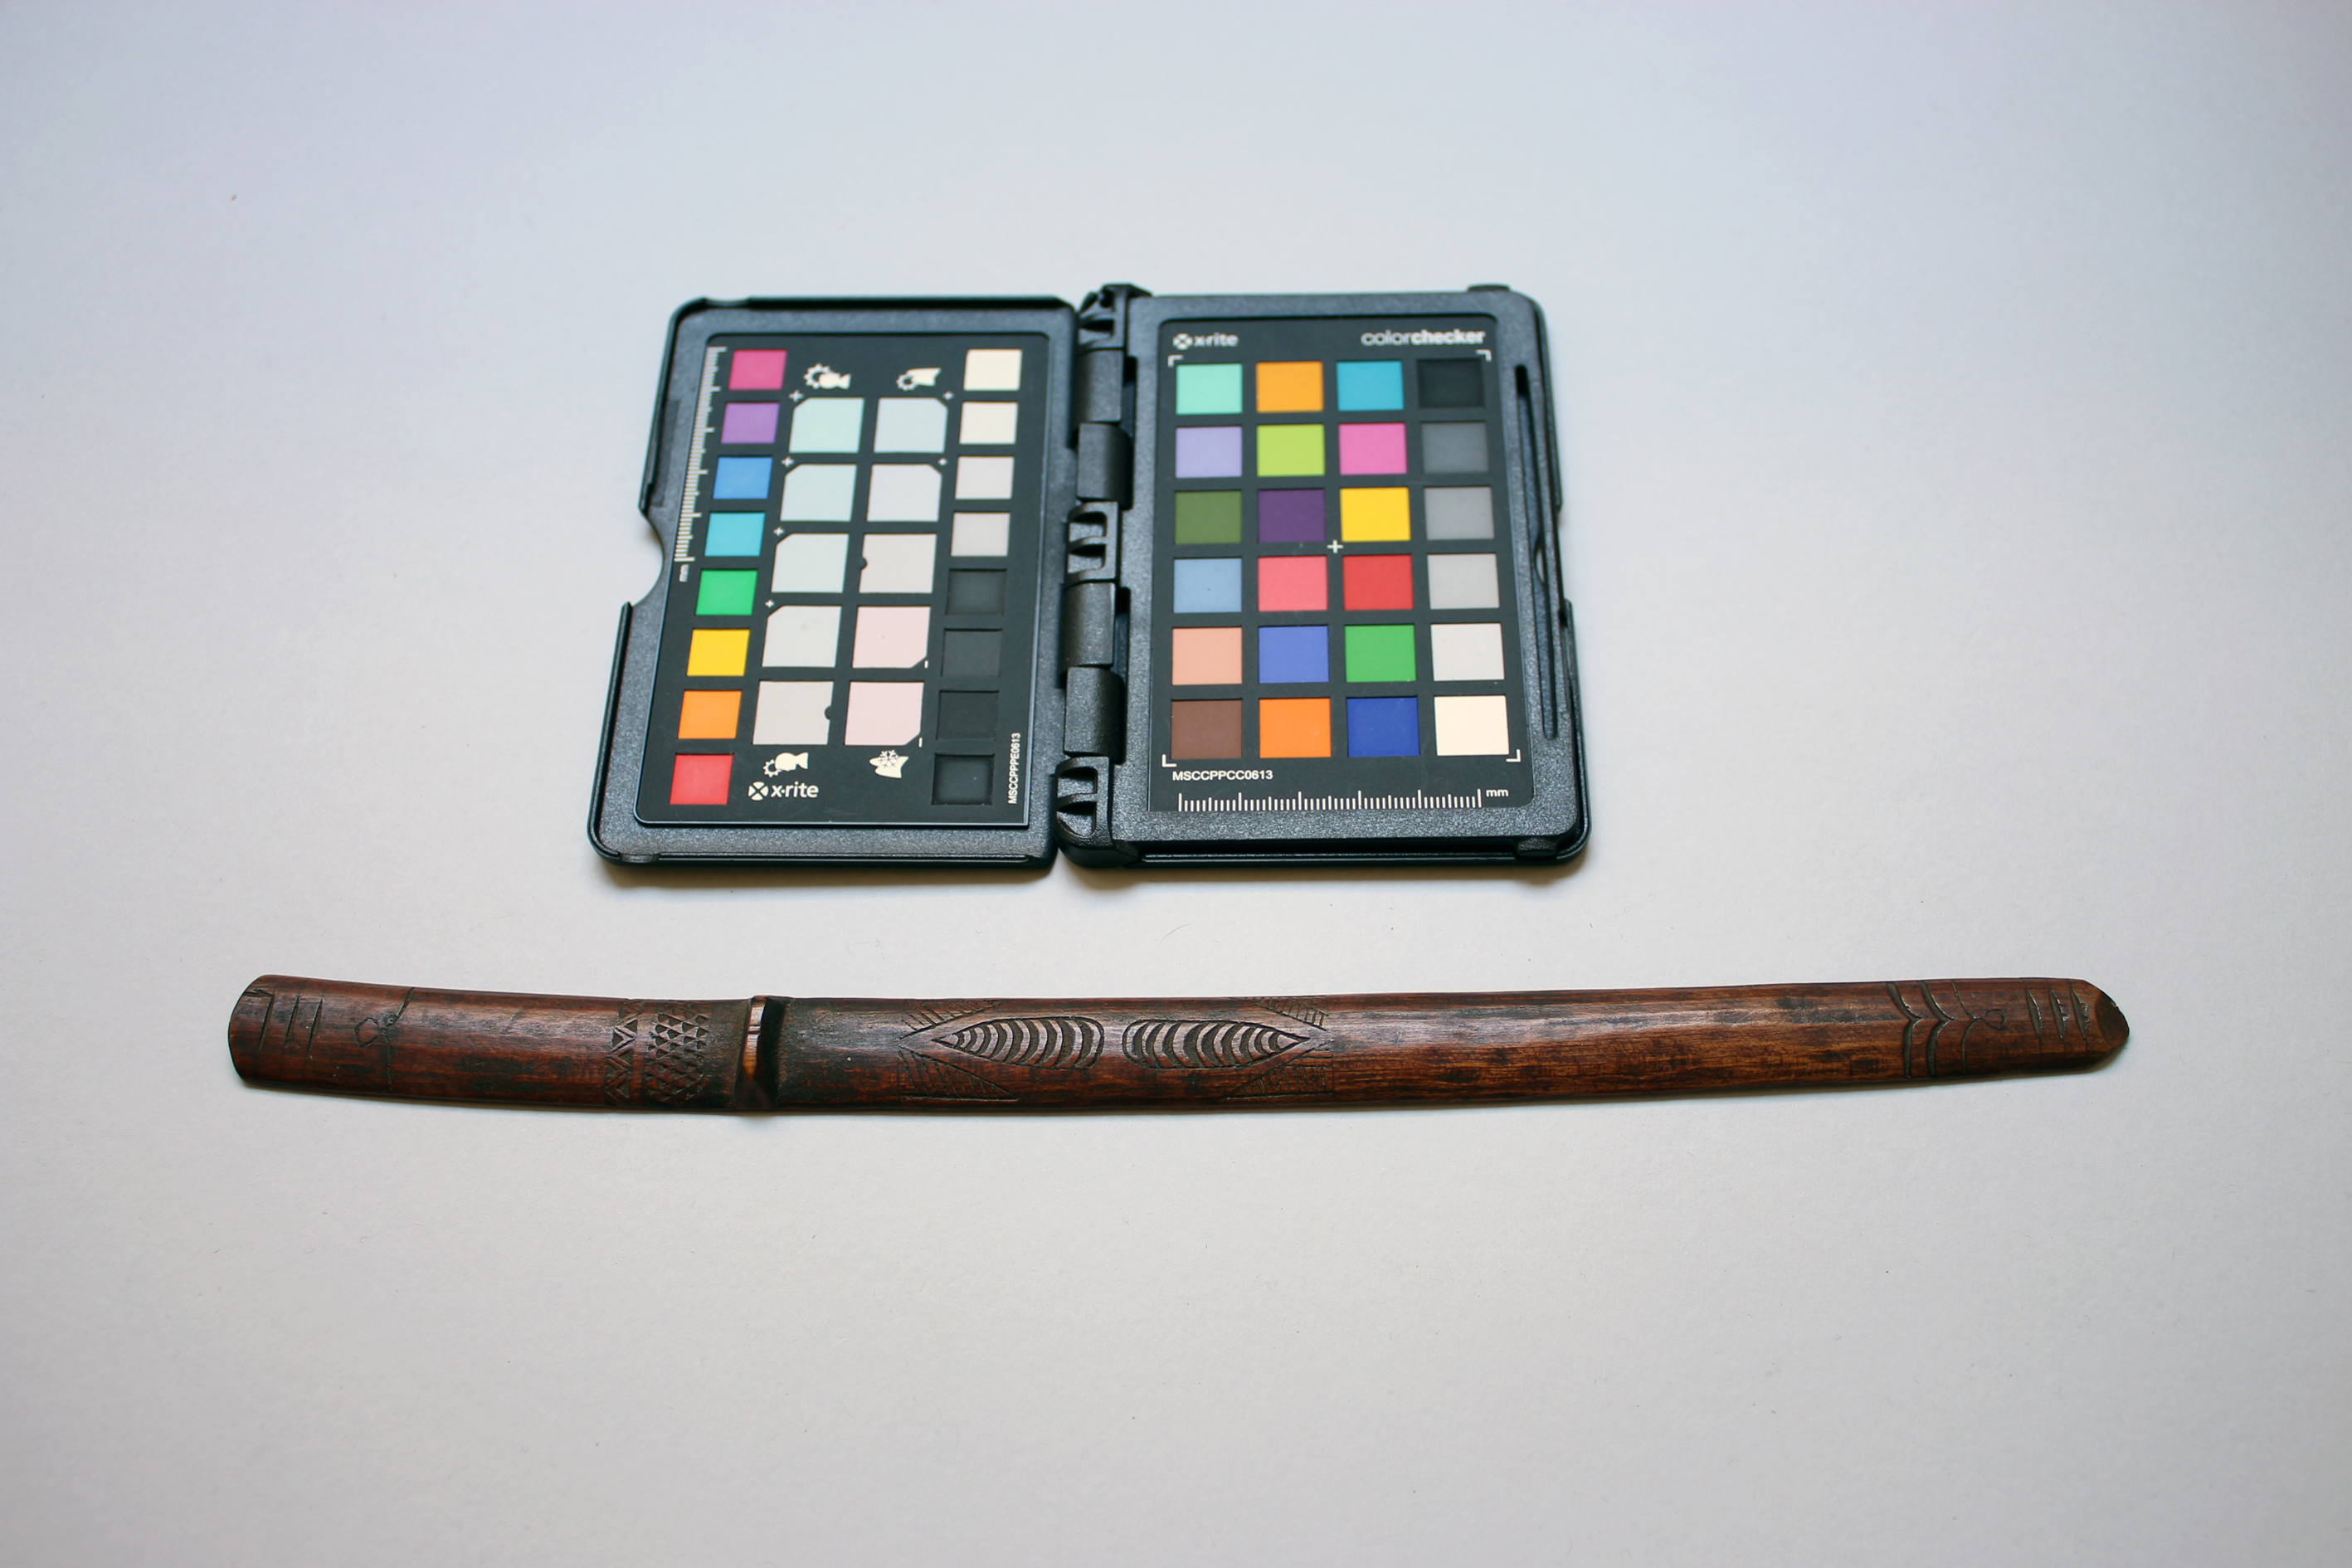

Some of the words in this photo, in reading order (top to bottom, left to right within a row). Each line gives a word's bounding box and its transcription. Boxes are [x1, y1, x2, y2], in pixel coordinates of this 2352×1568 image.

[1361, 329, 1486, 346] colorchecker
[1007, 733, 1021, 805] MSCCPPPE0613
[1172, 770, 1273, 781] MSCCPPCC0613
[1486, 789, 1509, 797] mm
